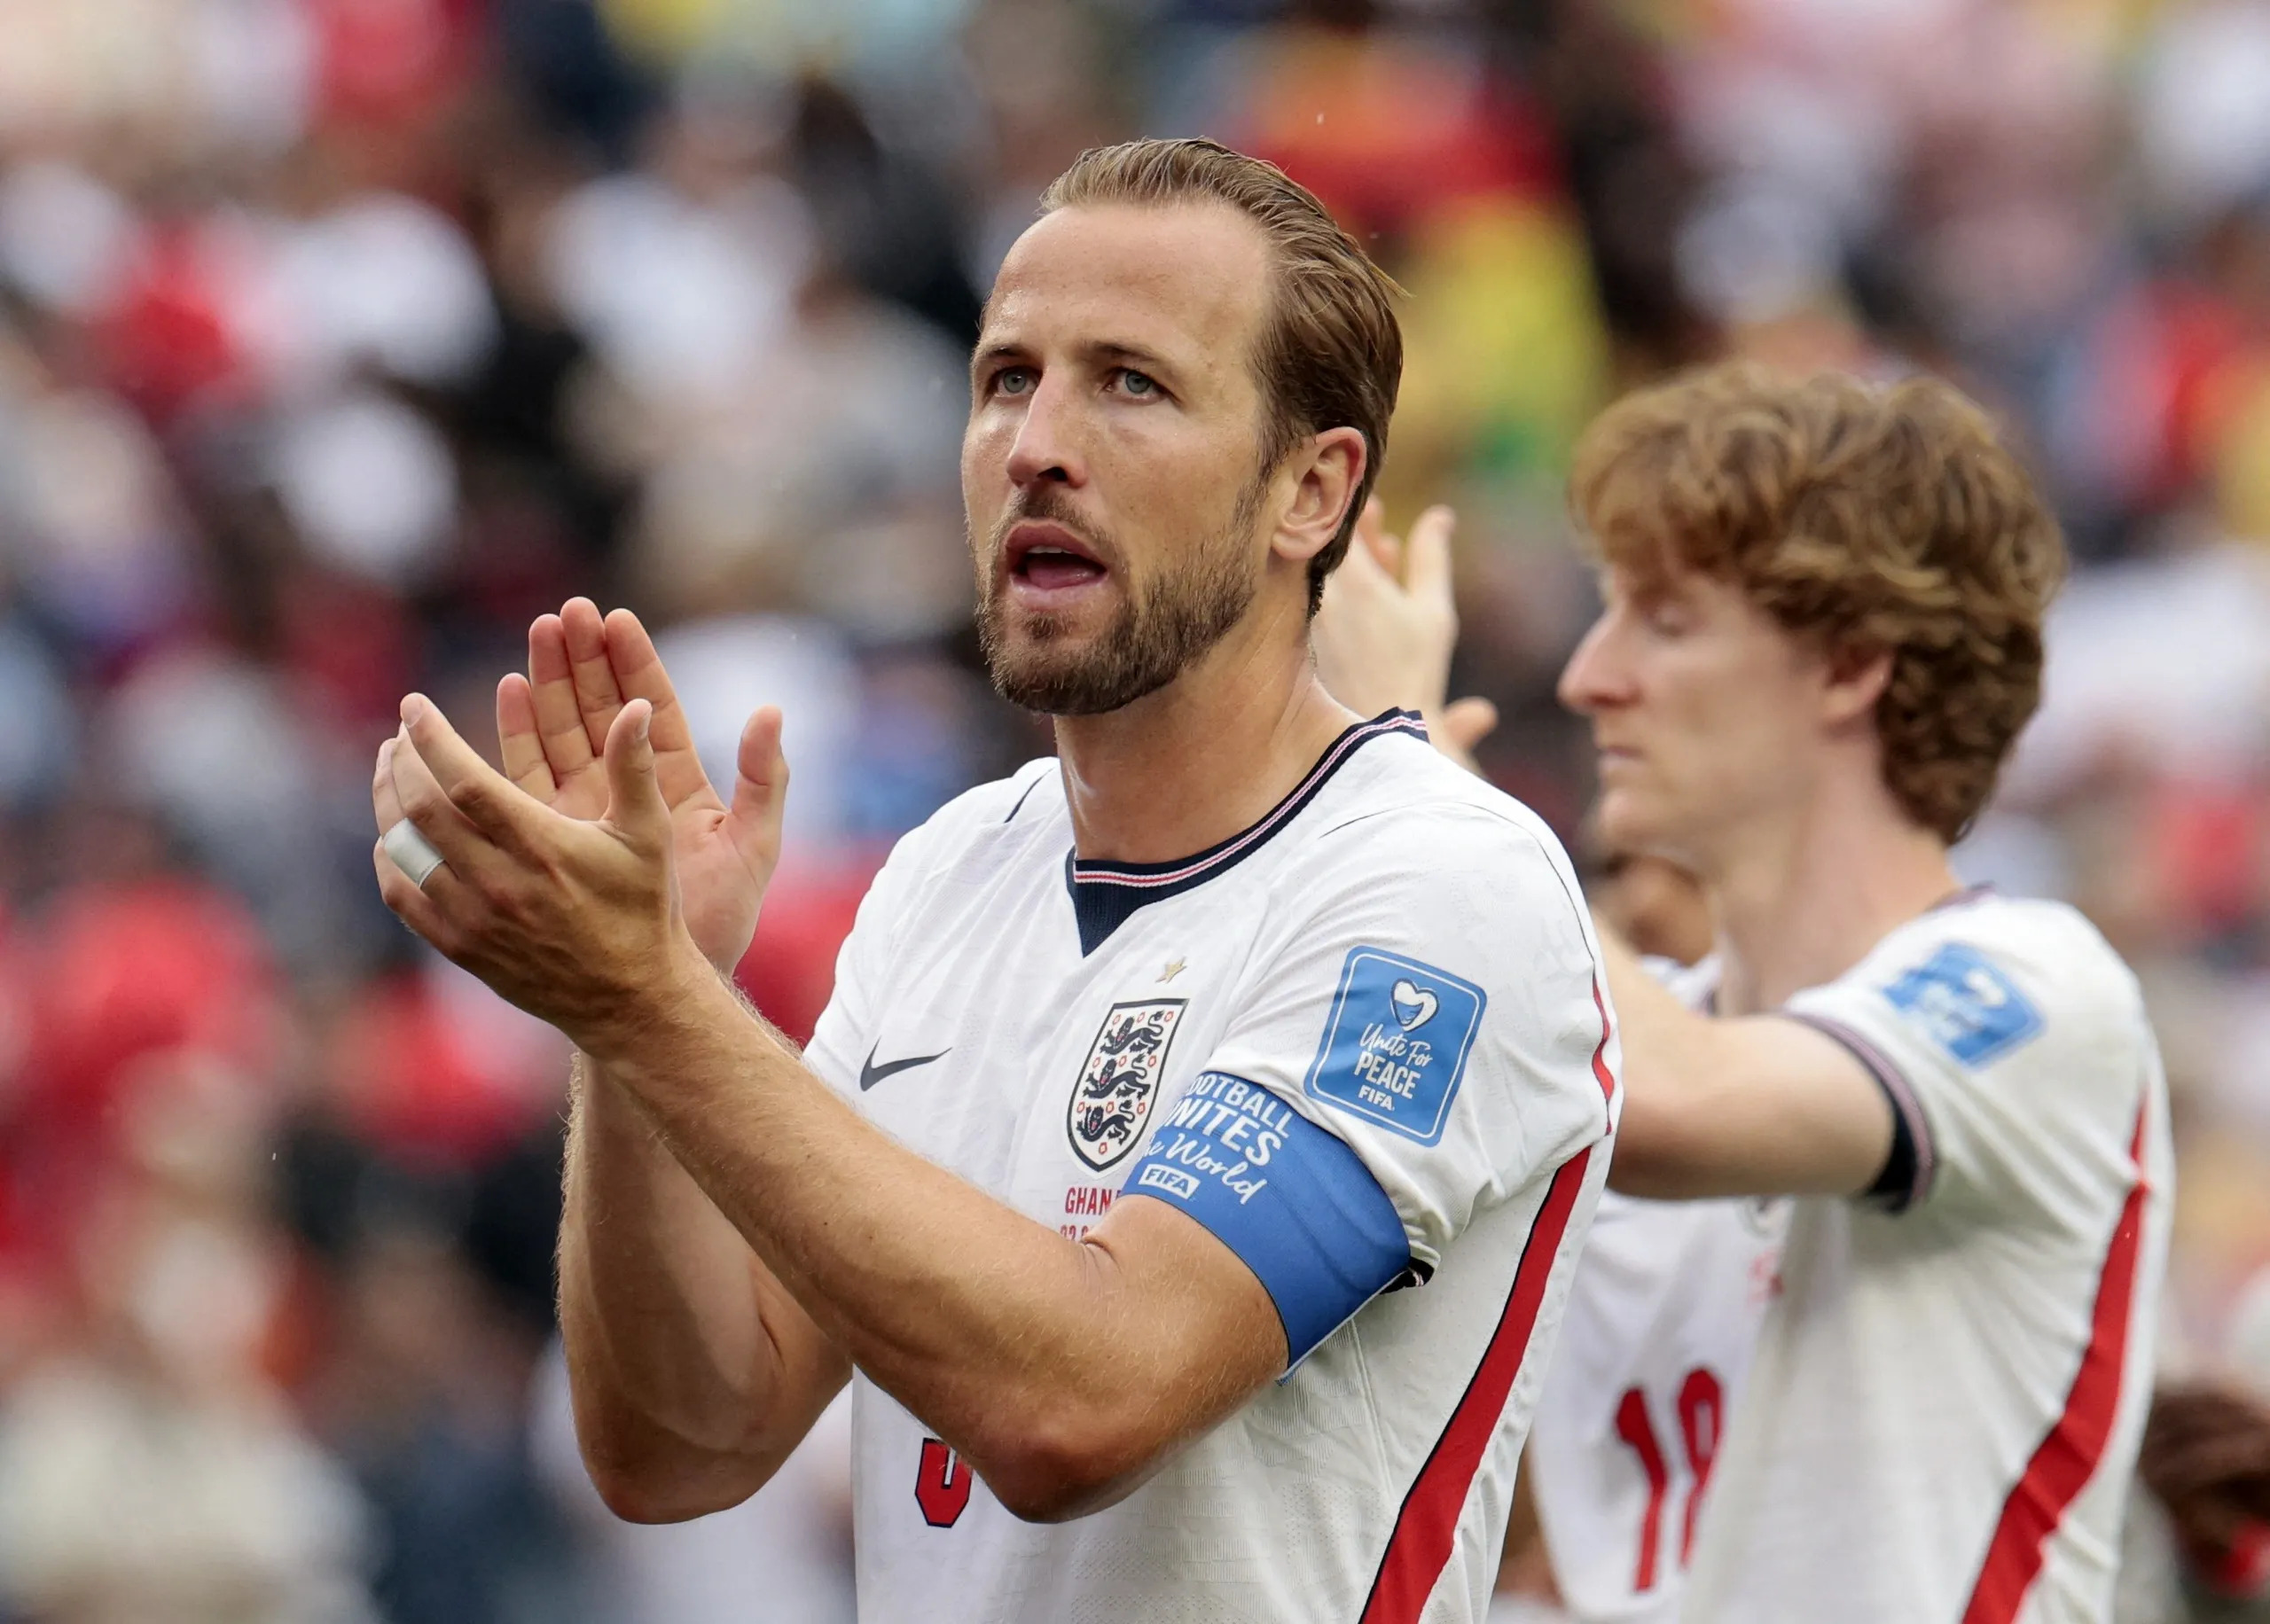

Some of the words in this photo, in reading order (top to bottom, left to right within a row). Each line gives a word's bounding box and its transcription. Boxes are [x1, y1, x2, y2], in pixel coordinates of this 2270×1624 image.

[1359, 1022, 1408, 1057] Unite
[1405, 1040, 1434, 1067] For
[1353, 1050, 1421, 1099] PEACE
[1358, 1084, 1395, 1112] FIFA
[1185, 1074, 1293, 1139] OOTBALL
[1159, 1097, 1281, 1166] NITES
[1145, 1167, 1190, 1193] FIFA
[1165, 1132, 1267, 1205] World
[1065, 1187, 1122, 1215] GHAN
